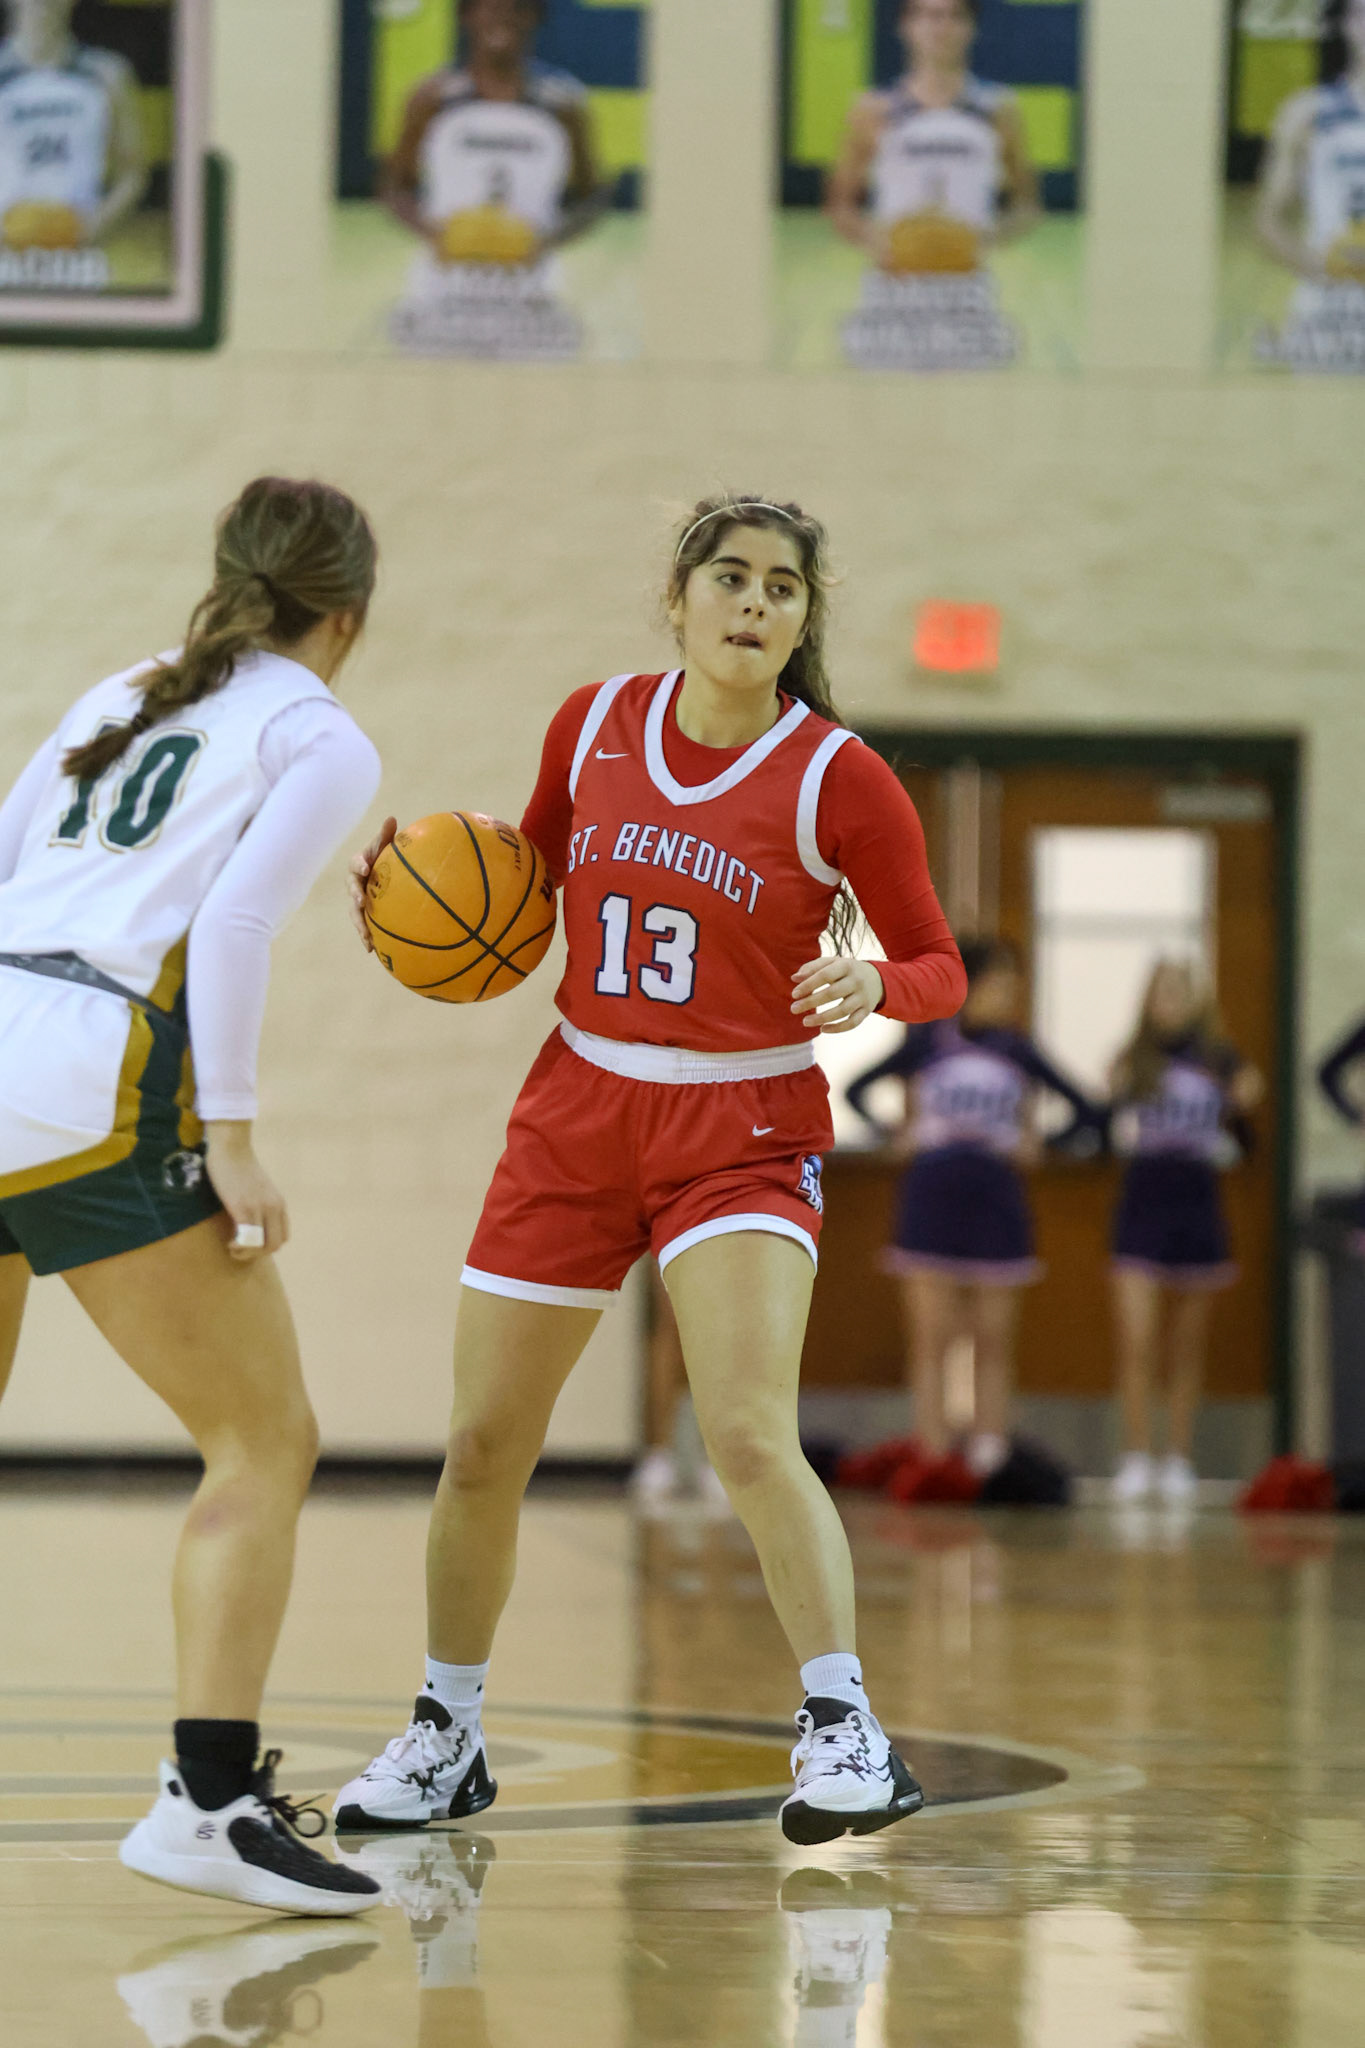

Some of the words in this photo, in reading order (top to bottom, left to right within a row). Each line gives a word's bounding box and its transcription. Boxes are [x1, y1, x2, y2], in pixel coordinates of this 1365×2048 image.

[48, 716, 208, 854] 10
[568, 823, 599, 874] ST.
[611, 821, 766, 915] BENEDICT
[594, 891, 700, 1006] 13
